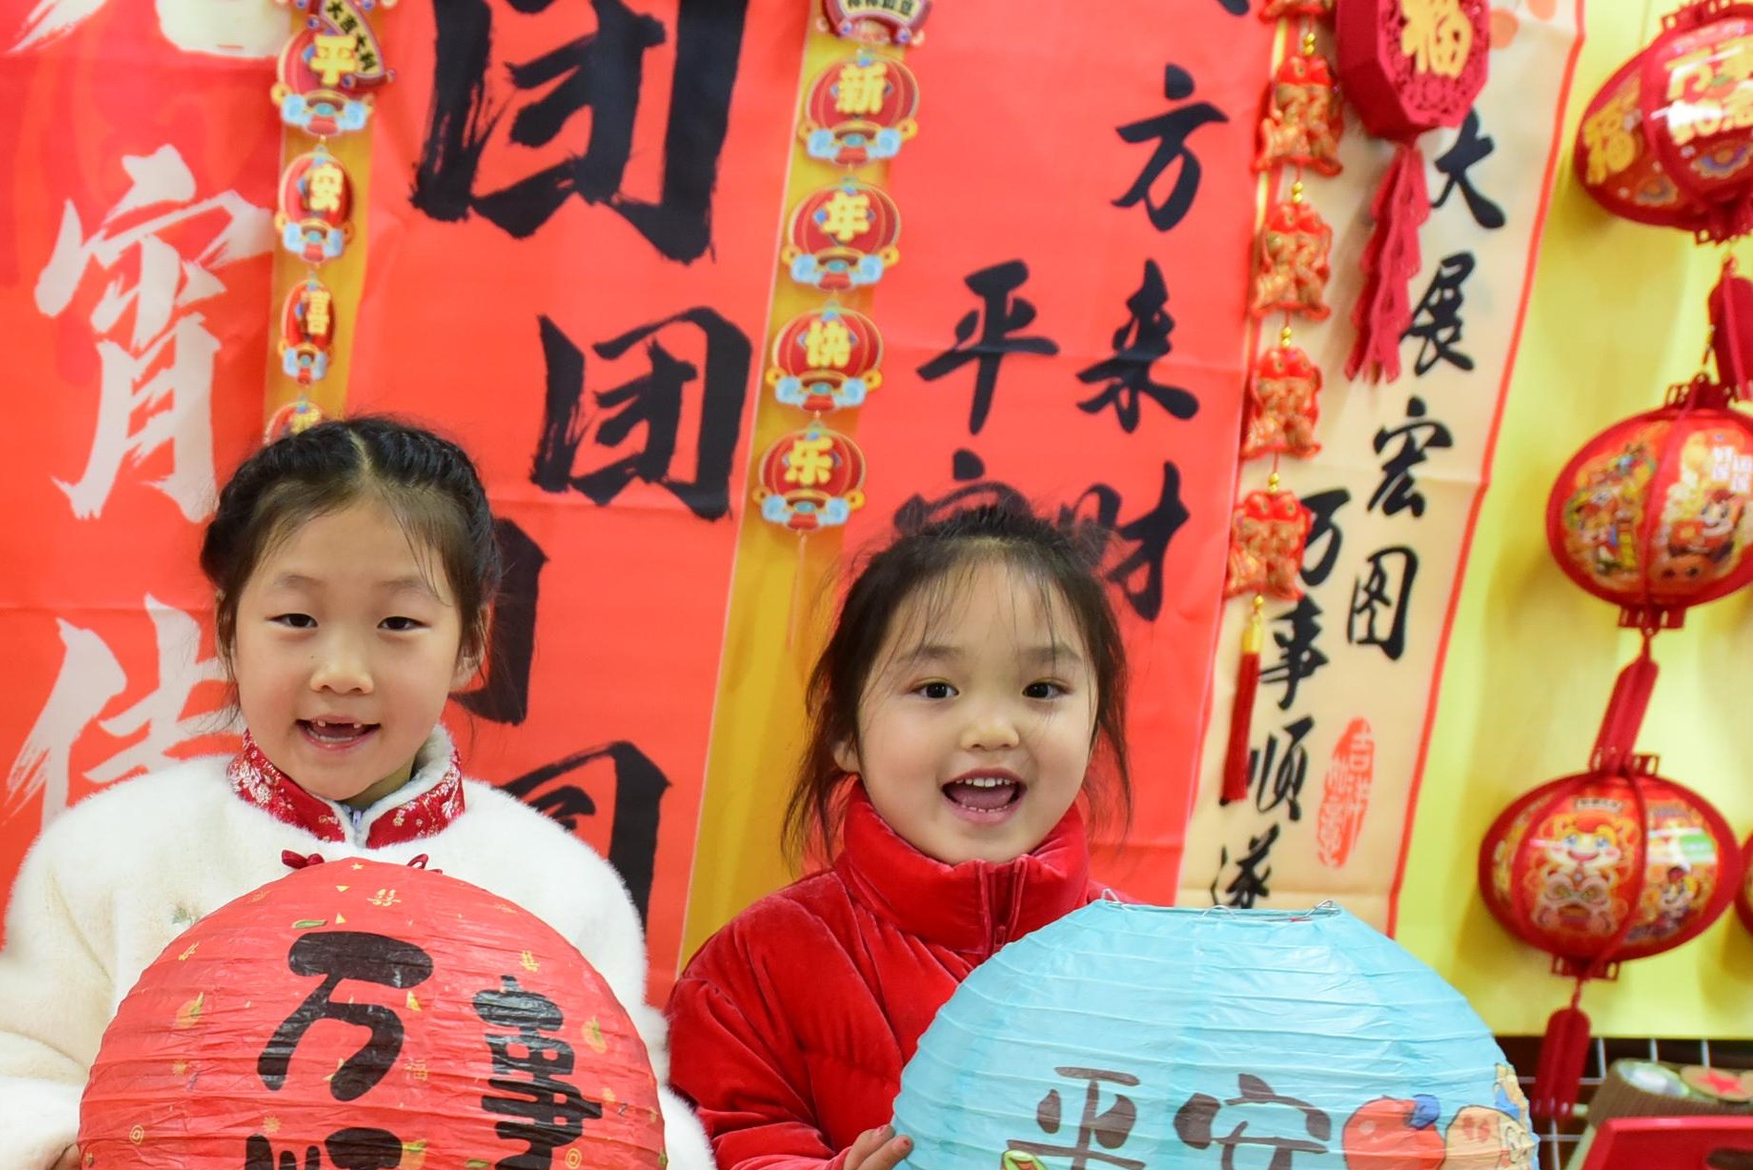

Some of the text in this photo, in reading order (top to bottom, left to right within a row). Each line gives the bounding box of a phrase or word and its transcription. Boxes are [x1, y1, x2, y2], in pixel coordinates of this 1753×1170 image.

[4, 0, 276, 825] 宵佳
[784, 62, 889, 484] 新年快乐
[1346, 106, 1506, 662] 大展宏图
